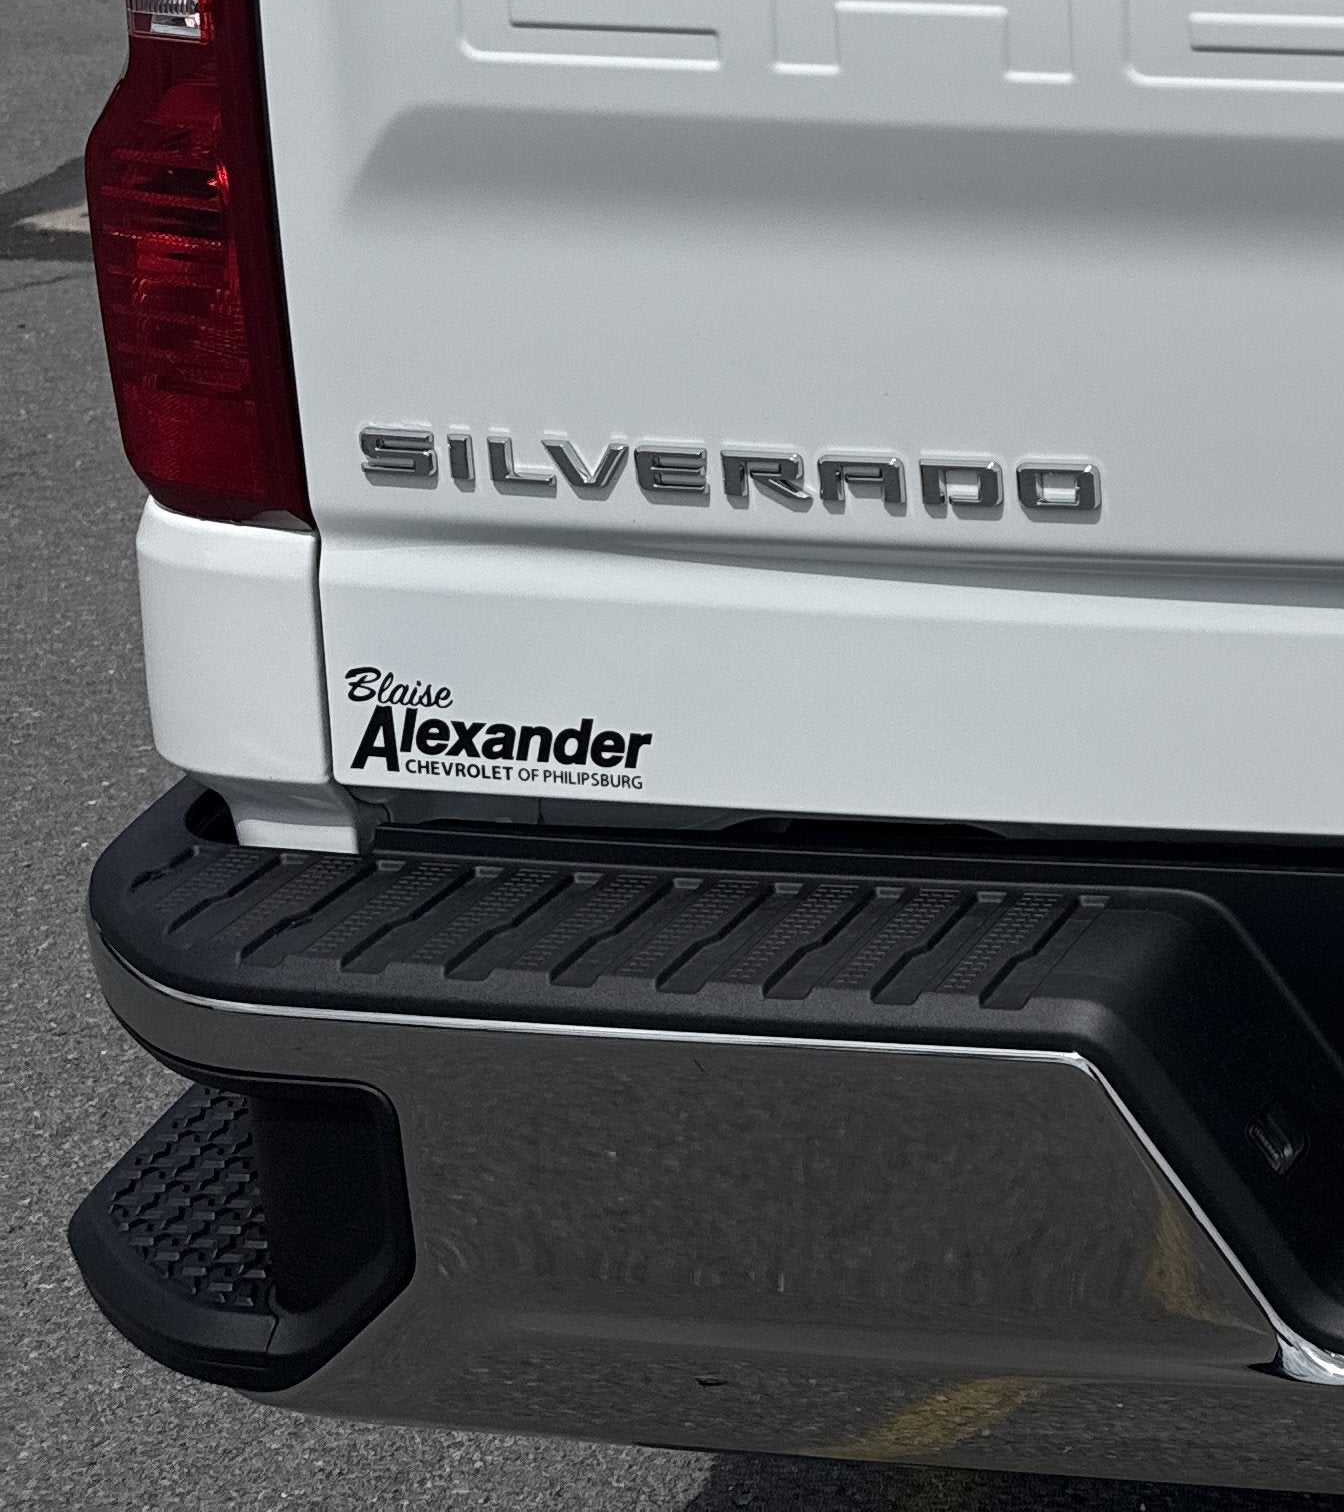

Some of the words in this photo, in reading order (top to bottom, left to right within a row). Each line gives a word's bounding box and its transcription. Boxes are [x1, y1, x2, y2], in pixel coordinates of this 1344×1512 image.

[359, 426, 1103, 511] SILVERADO
[344, 666, 454, 708] Blaise
[350, 704, 653, 772] Alexander
[405, 759, 514, 781] CHEVROLET
[518, 767, 540, 782] OF
[543, 769, 643, 790] PHILIPSBURG
